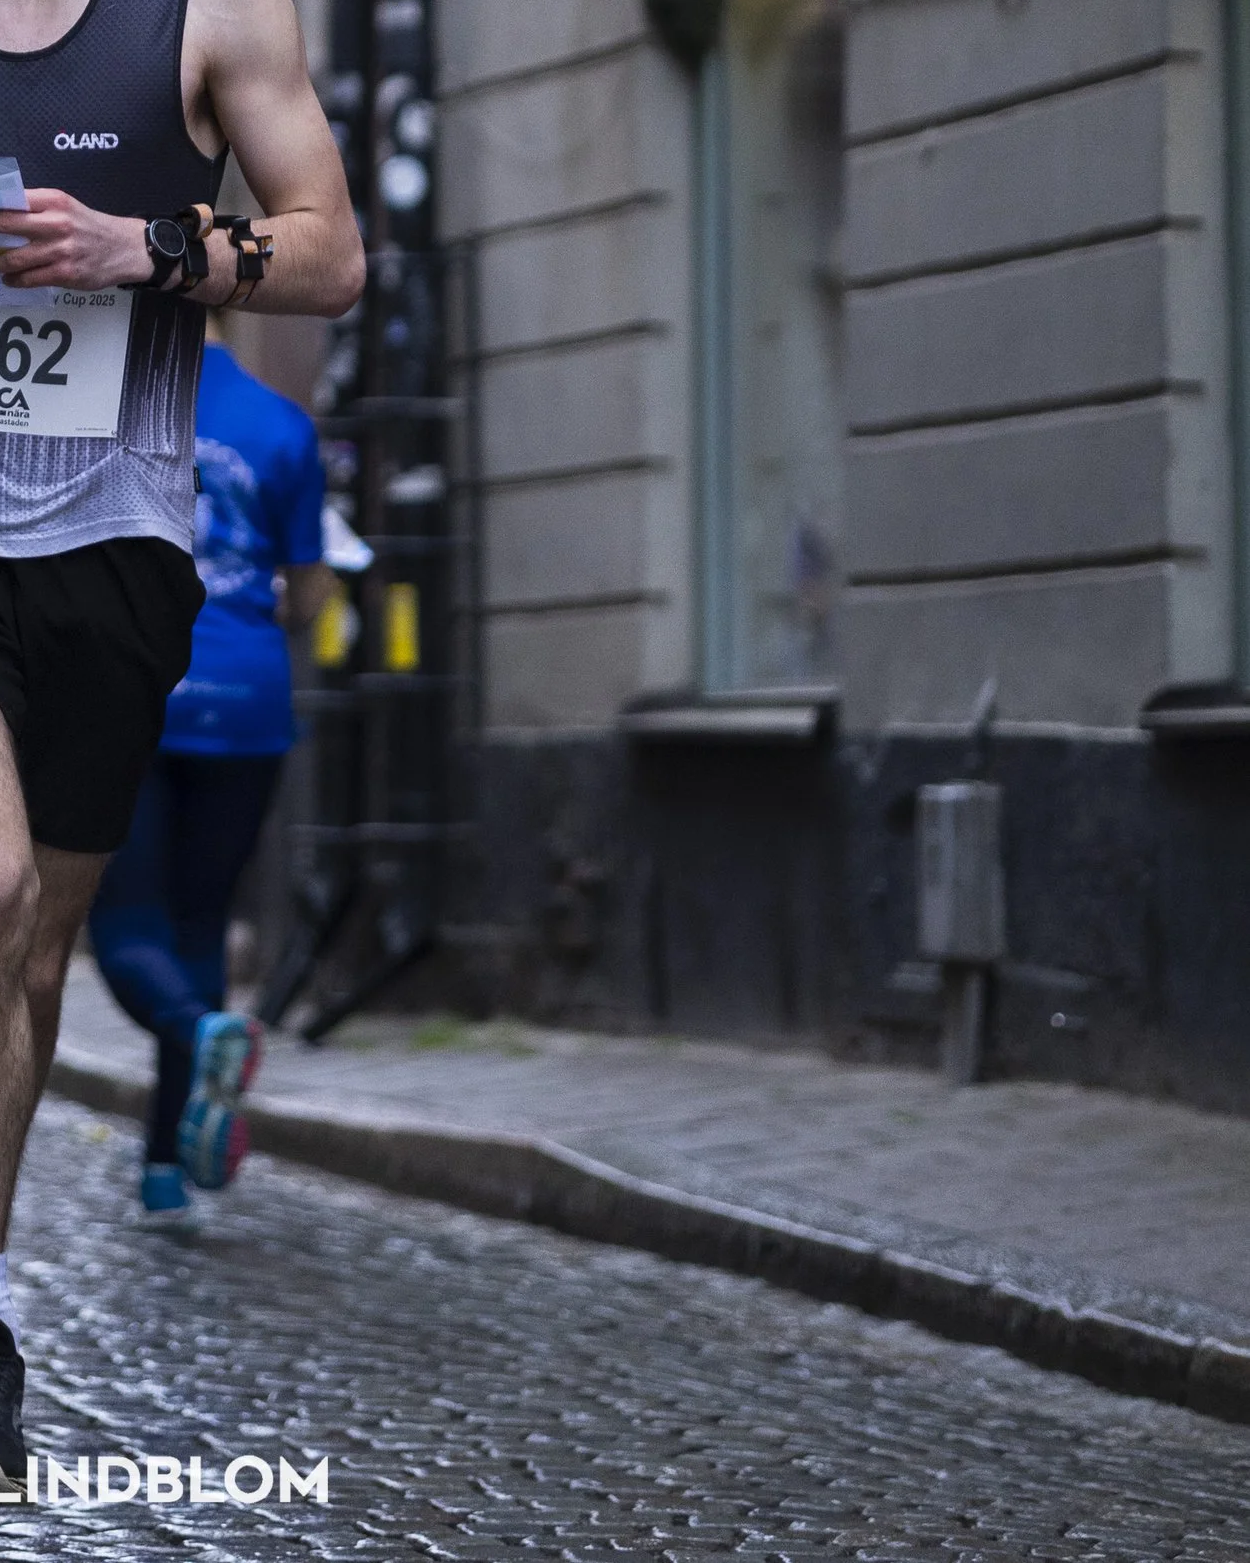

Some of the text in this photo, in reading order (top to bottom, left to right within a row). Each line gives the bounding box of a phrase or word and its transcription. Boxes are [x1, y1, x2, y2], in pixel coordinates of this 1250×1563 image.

[63, 292, 86, 308] Cup
[89, 293, 116, 307] 2025
[7, 409, 30, 419] nära
